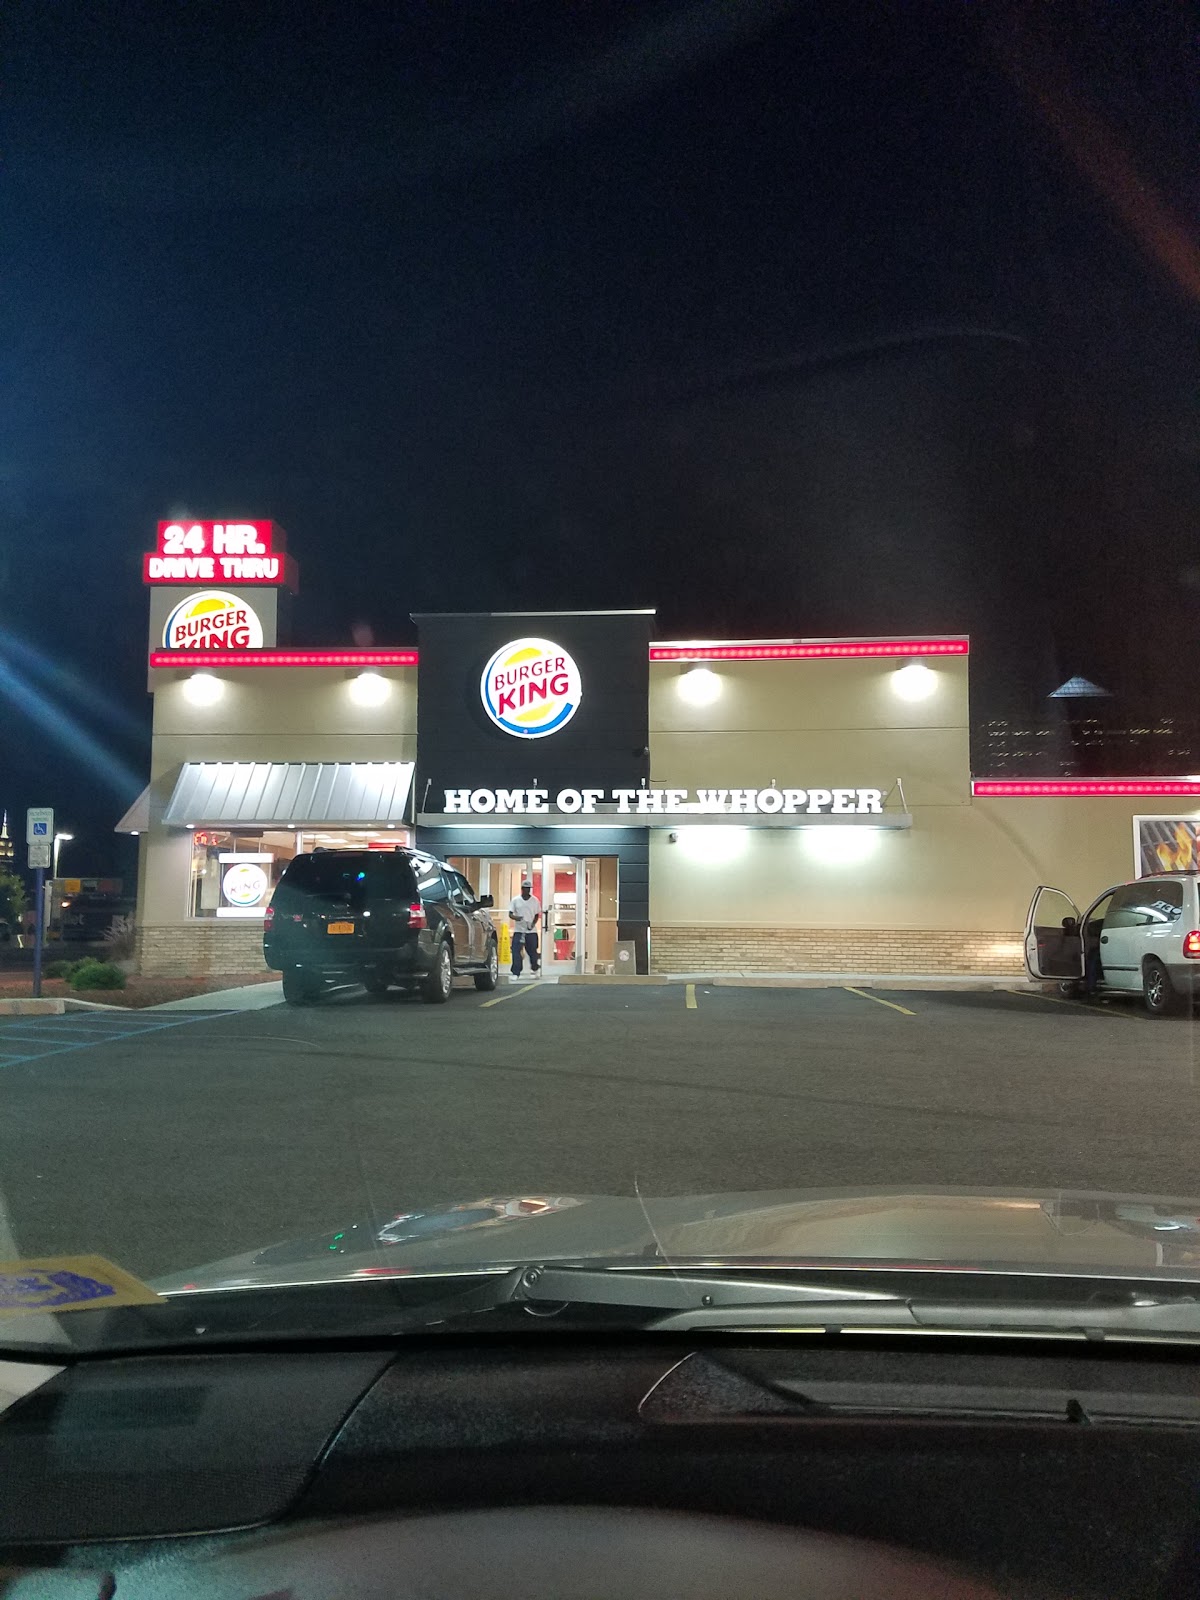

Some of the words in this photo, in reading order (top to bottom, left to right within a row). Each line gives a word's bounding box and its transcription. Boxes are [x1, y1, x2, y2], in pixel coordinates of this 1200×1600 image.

[163, 525, 205, 554] 24
[212, 524, 266, 554] HR.
[149, 557, 215, 578] DRIVE
[220, 557, 279, 578] THRU
[175, 610, 247, 643] BURGER
[495, 657, 566, 691] BURGER
[499, 673, 569, 716] KING
[443, 788, 549, 814] HOME
[556, 788, 605, 814] OF
[612, 789, 688, 814] THE
[696, 788, 883, 814] WHOPPER
